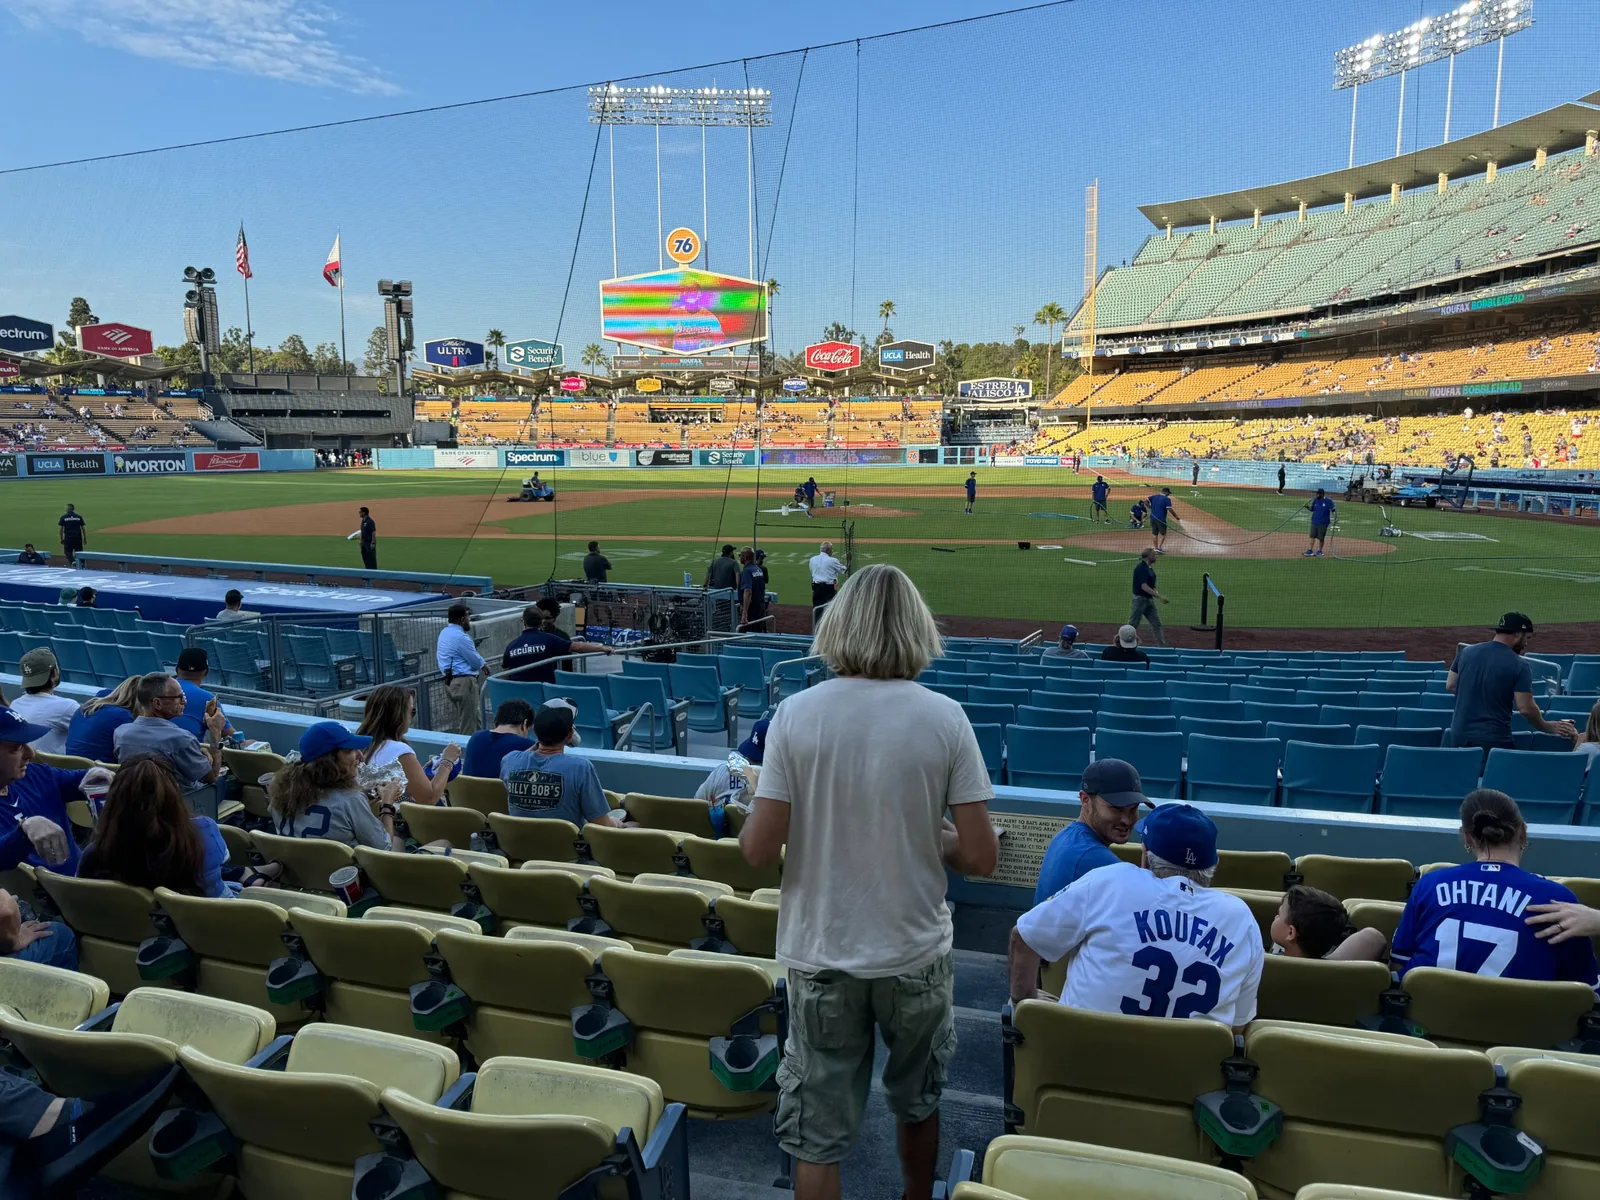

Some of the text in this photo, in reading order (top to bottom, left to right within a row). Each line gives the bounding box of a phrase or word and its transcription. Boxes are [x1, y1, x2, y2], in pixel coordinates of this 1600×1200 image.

[674, 238, 693, 253] 76
[1441, 302, 1470, 315] KOUFAX
[1471, 293, 1525, 311] BOBBLEHEAD
[437, 347, 472, 355] ULTRA
[527, 347, 559, 356] Security
[883, 351, 931, 360] UCLA Health
[964, 389, 1012, 398] JALISCO
[1404, 389, 1429, 398] SANDY
[1429, 387, 1461, 397] KOUFAX
[1462, 381, 1523, 396] BOBBLEHEAD
[507, 452, 557, 464] Spectrum
[581, 451, 606, 461] blue
[721, 451, 746, 459] Security
[38, 460, 99, 469] UCLA Health
[124, 460, 186, 472] MORTON
[509, 644, 546, 658] SECURITY
[531, 784, 560, 797] BOB'S
[1185, 848, 1197, 865] LA
[1436, 880, 1532, 918] OHTANI
[1133, 909, 1235, 969] KOUFAX
[1435, 917, 1519, 978] 17
[1120, 945, 1221, 1019] 32
